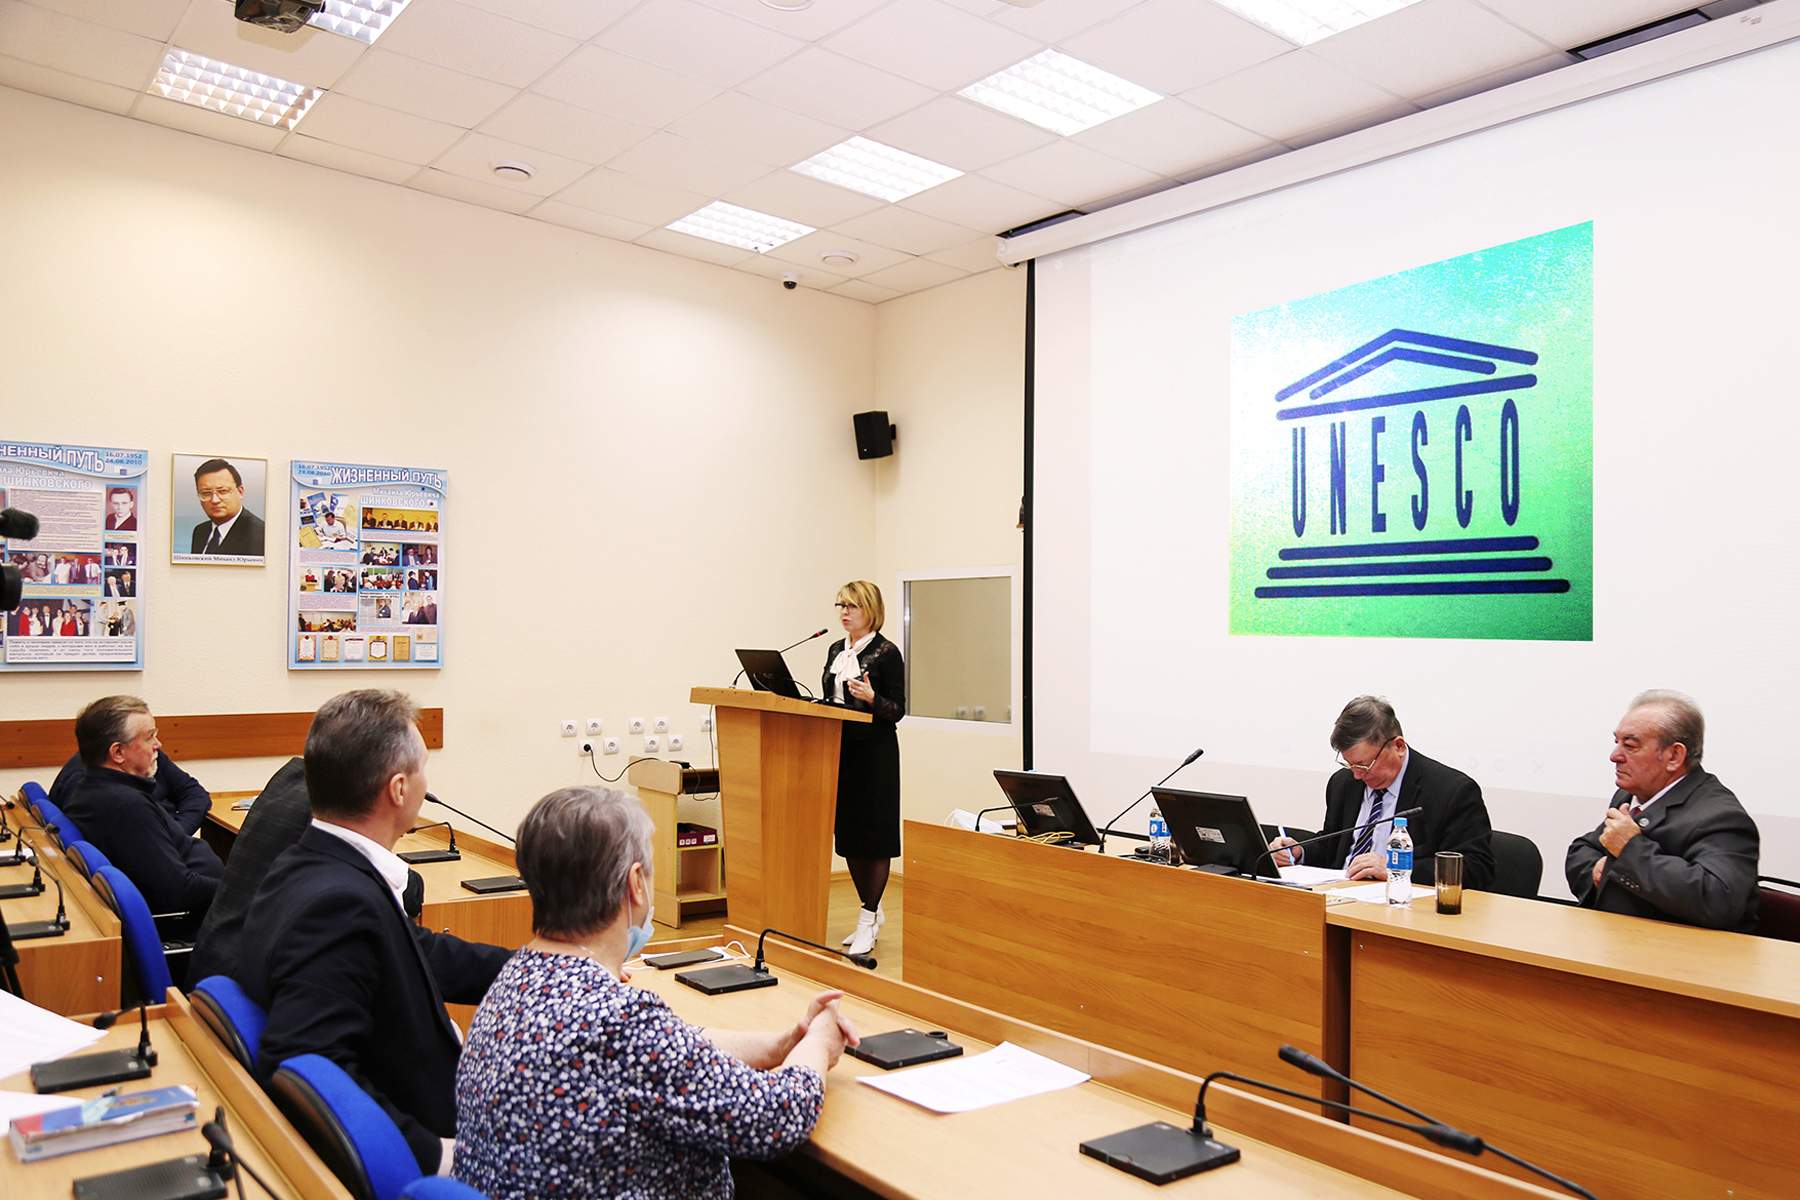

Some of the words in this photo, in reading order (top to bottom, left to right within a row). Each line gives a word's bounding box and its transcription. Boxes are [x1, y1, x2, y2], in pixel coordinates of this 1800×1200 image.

[67, 449, 104, 473] ПУТЬ
[1292, 398, 1520, 538] UNESCO
[331, 467, 410, 485] ЖИЗНЕННЫЙ
[412, 471, 443, 489] ПУТЬ
